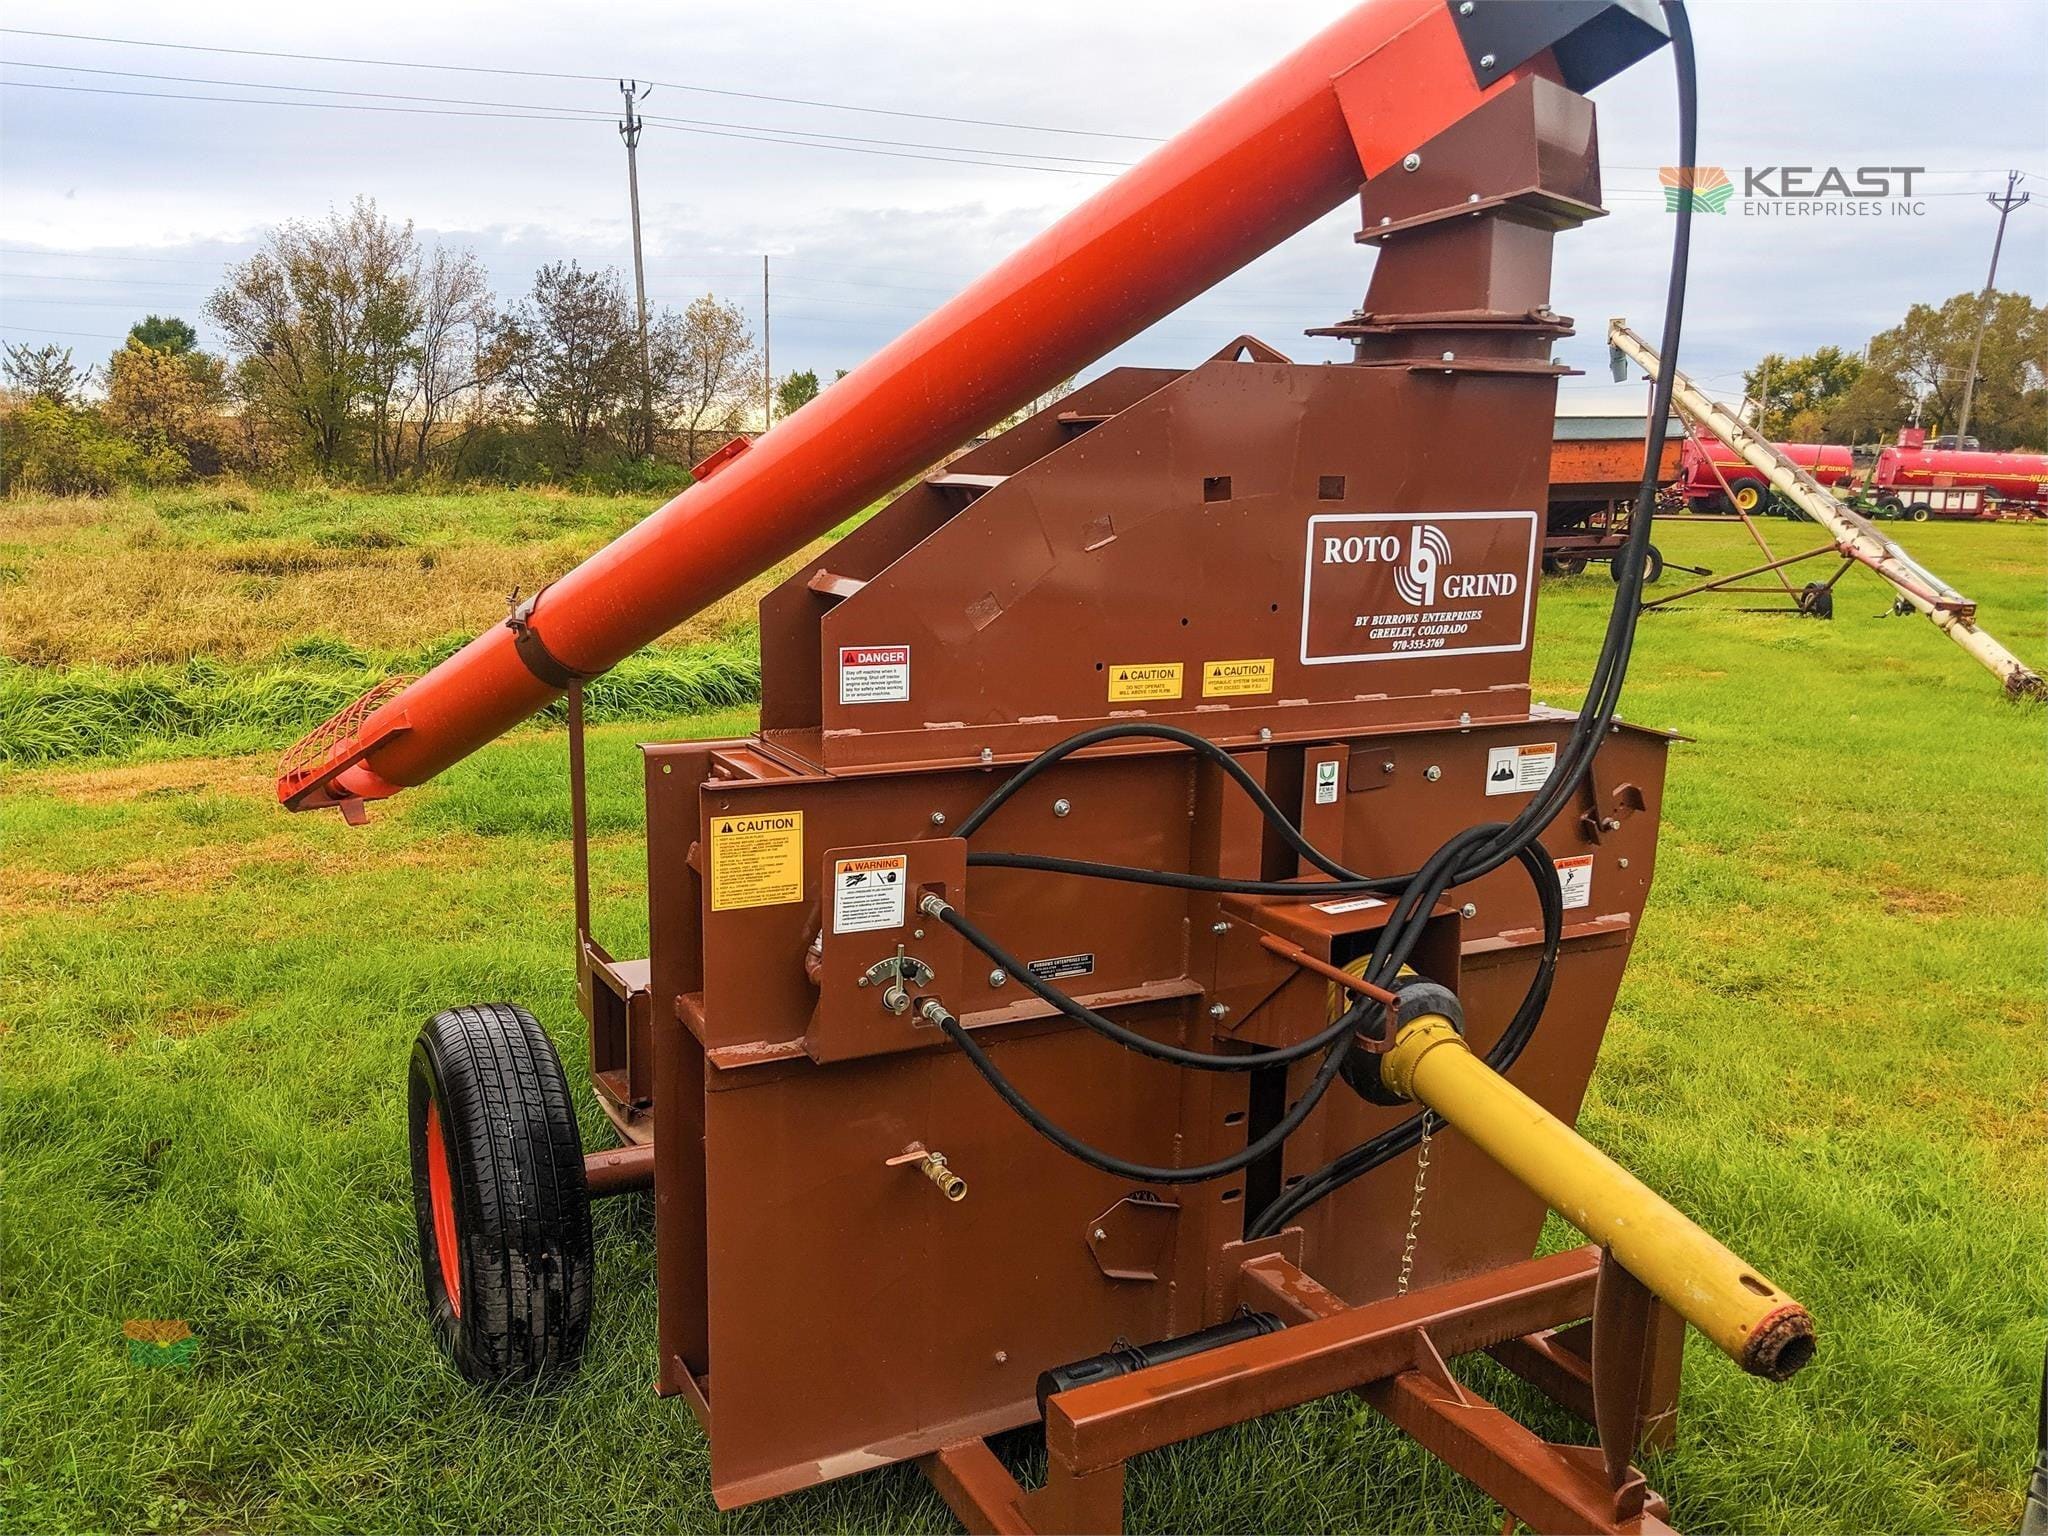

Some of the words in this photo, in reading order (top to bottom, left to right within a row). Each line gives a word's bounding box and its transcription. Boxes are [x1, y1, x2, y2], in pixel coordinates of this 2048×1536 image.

[1323, 536, 1400, 564] ROTO
[1443, 573, 1518, 598] GRIND
[1355, 616, 1368, 626] BY
[1371, 613, 1419, 625] BURROWS
[1421, 611, 1482, 622] ENTERPRISES
[1370, 627, 1416, 639] GREELEY,
[1418, 624, 1468, 636] COLORADO
[1392, 638, 1444, 651] 970-353-3769
[858, 652, 904, 663] DANGER
[1131, 669, 1174, 680] CAUTION
[1224, 665, 1265, 676] CAUTION
[737, 818, 793, 832] CAUTION
[855, 860, 898, 870] WARNING
